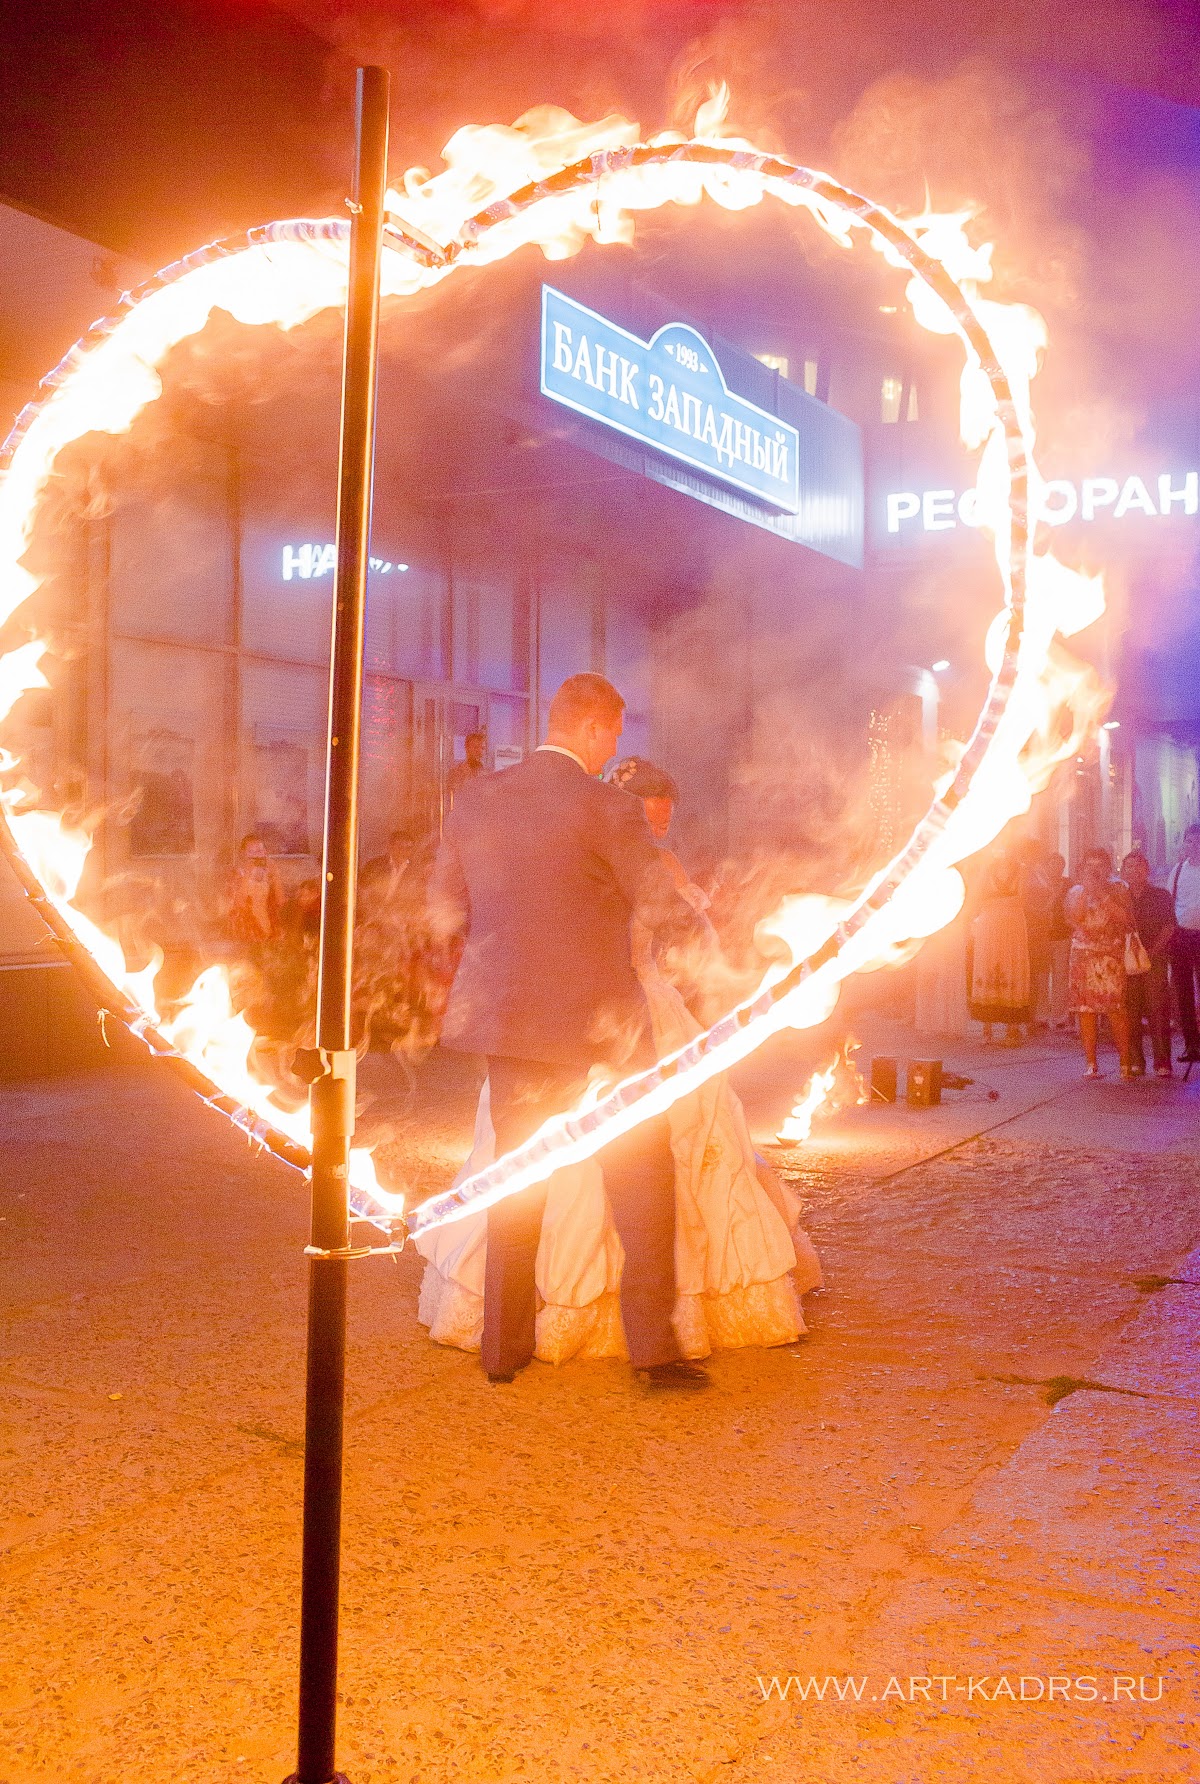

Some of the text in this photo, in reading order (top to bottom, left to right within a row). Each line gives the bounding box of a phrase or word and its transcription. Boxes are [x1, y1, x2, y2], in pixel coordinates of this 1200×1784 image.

[676, 342, 699, 373] 1993
[551, 320, 789, 483] БАНК ЗАПАДНЫЙ
[886, 471, 1199, 533] РЕСОРАН
